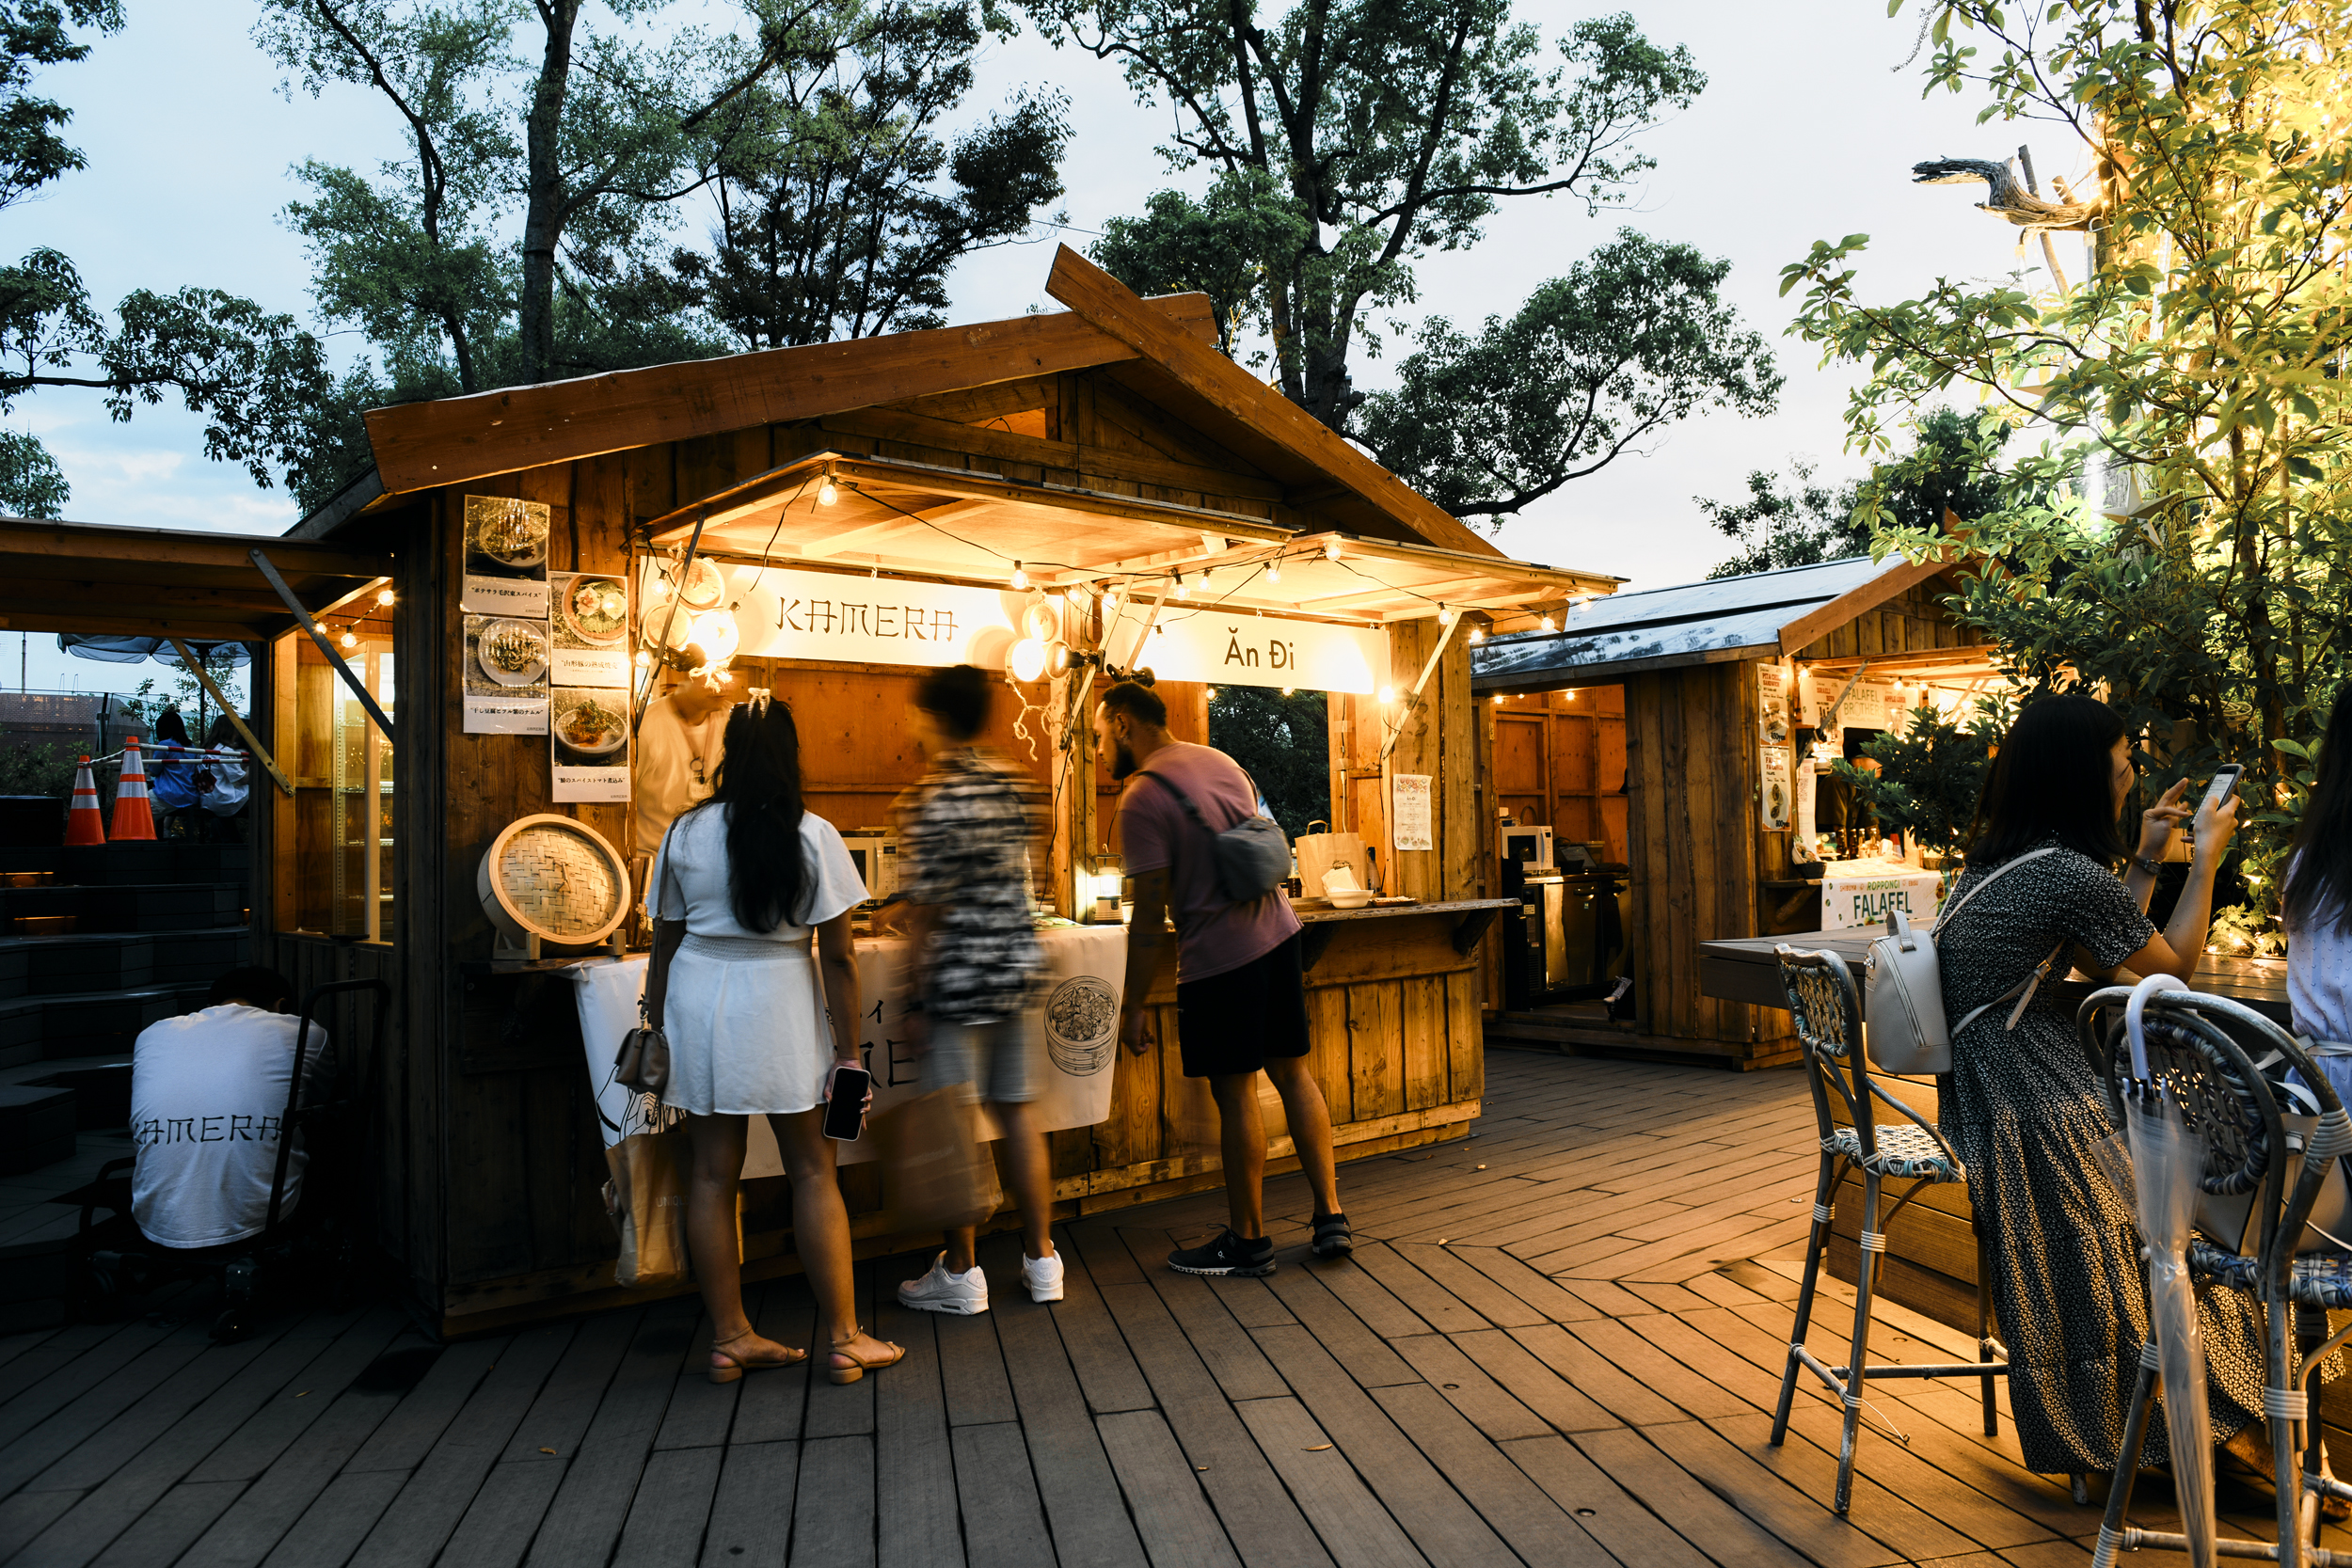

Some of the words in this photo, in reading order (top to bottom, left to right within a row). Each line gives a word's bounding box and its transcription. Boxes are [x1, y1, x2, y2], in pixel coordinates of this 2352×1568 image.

[775, 596, 959, 641] KAMERA
[1224, 626, 1259, 668] Ăn
[1268, 639, 1295, 671] Đi
[1844, 702, 1884, 719] BROTHERS
[1839, 883, 1857, 893] SHIBUYA
[1867, 879, 1900, 891] ROPPONGI
[1853, 891, 1913, 919] FALAFEL
